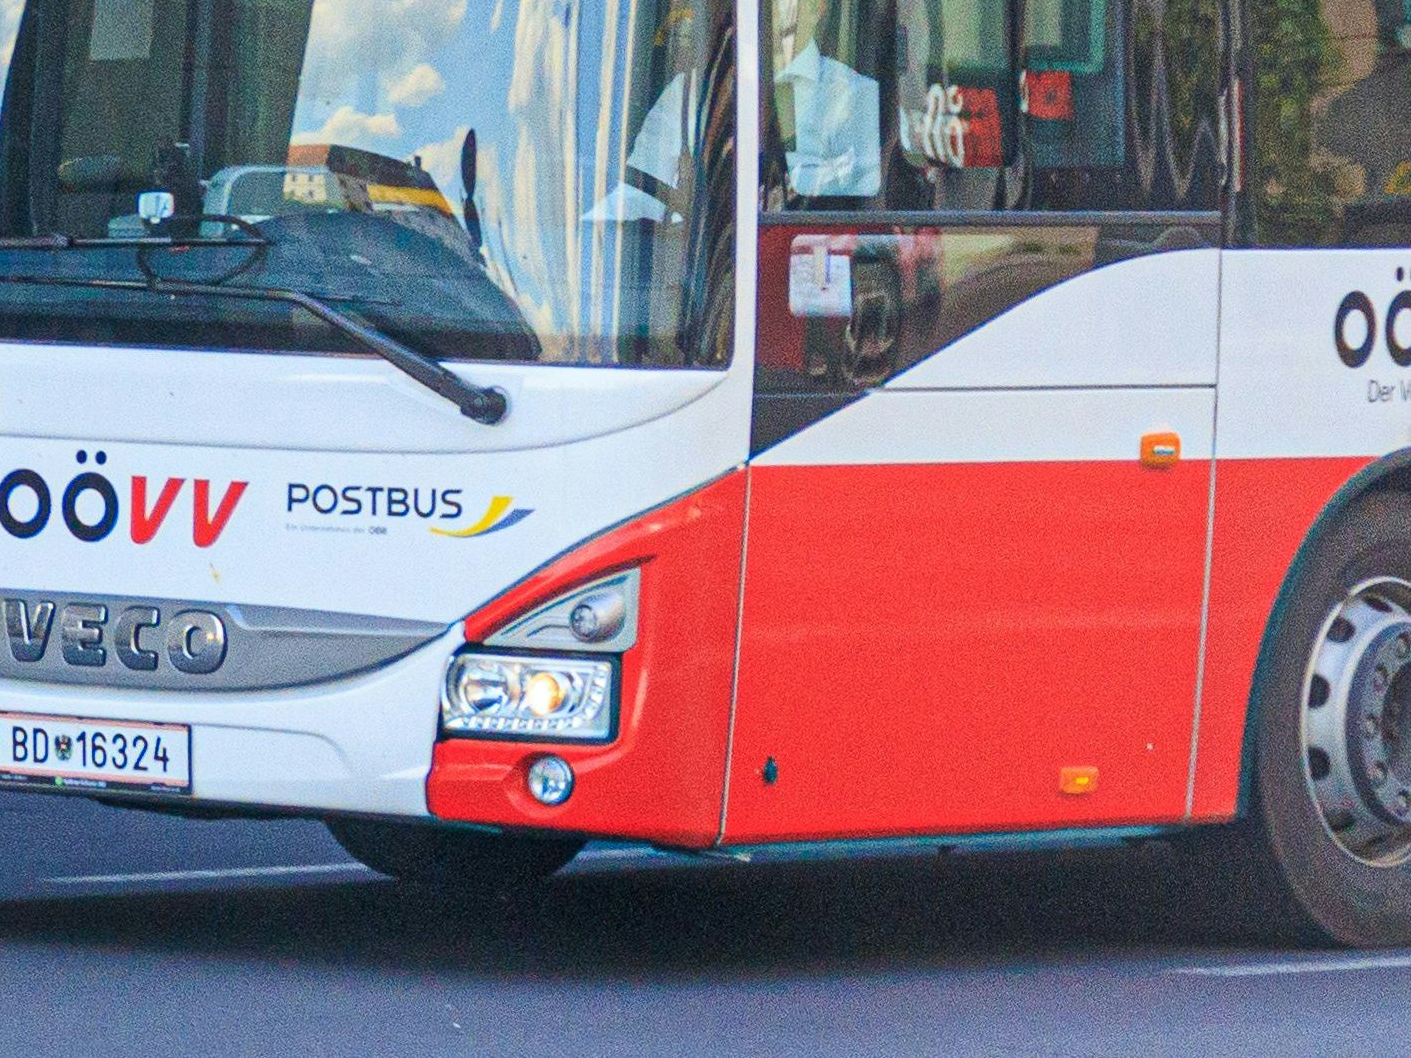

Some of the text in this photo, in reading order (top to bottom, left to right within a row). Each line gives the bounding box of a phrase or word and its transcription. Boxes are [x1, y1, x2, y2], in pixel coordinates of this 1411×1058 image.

[286, 482, 464, 519] POSTBUS
[12, 725, 170, 773] BD 16324
